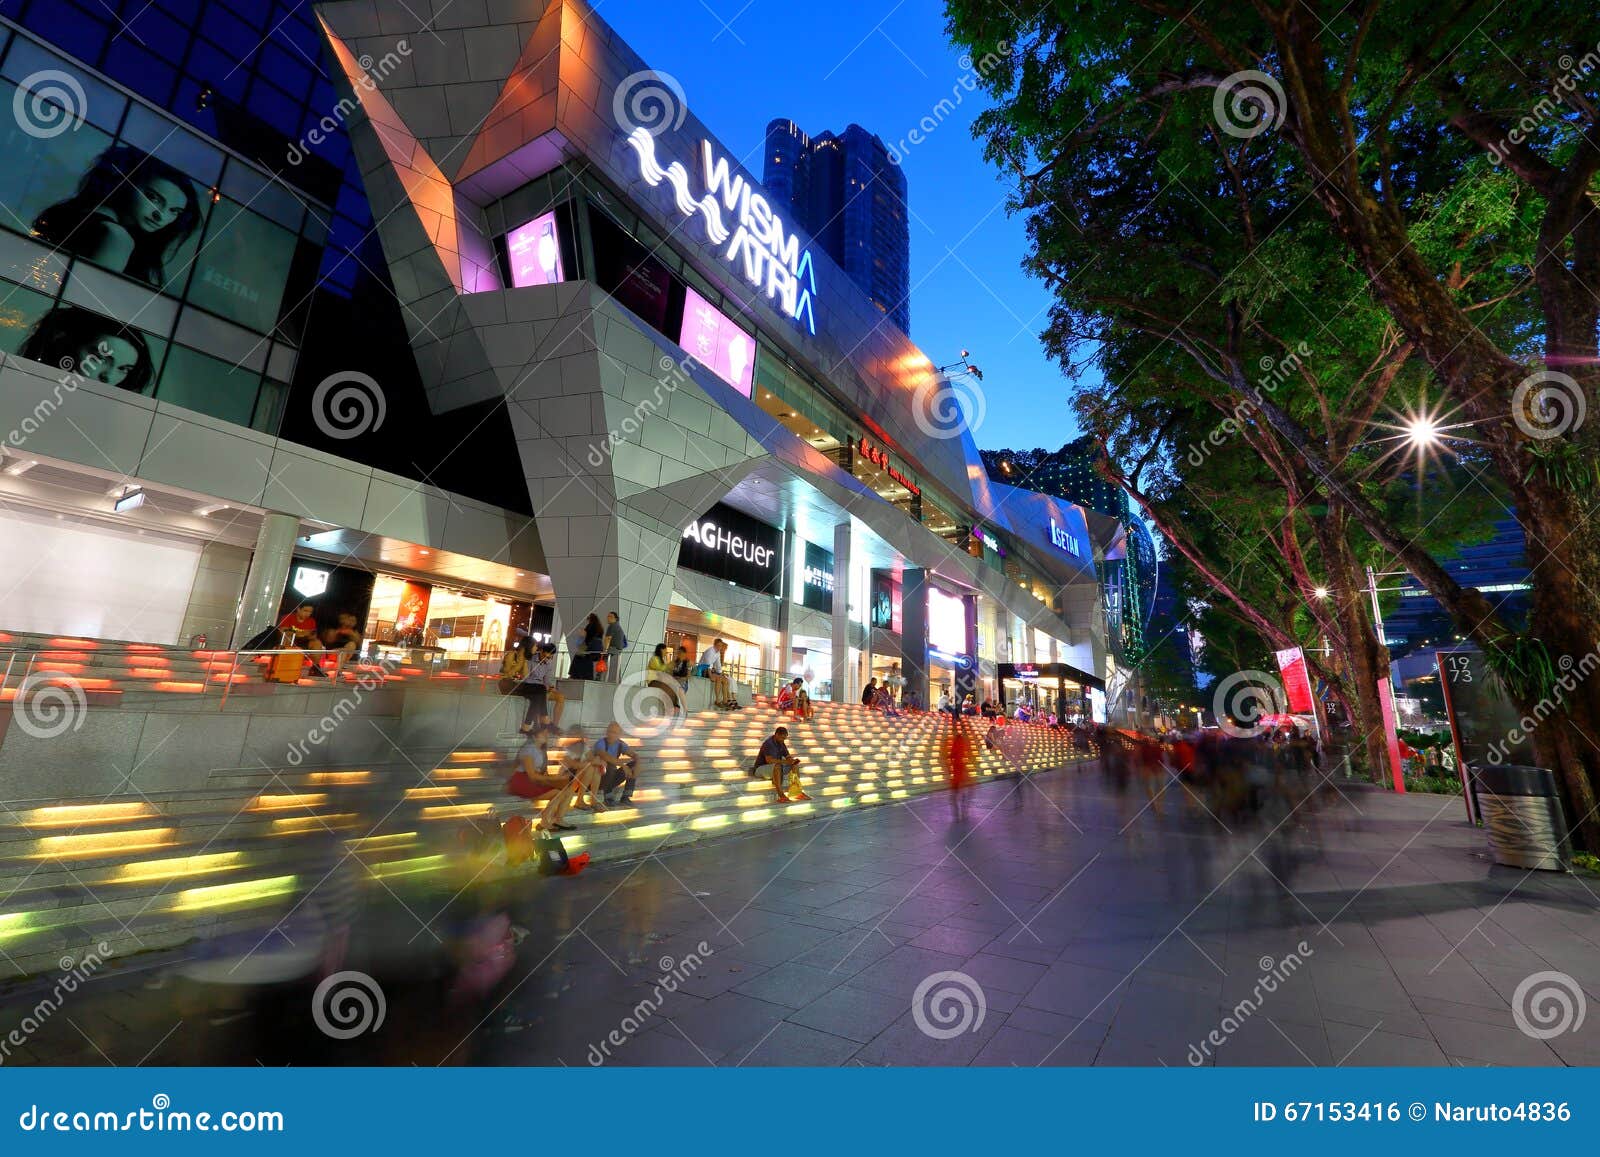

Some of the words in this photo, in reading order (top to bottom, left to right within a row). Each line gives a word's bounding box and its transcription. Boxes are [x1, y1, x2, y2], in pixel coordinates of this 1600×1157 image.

[702, 138, 816, 296] WISMA
[726, 224, 816, 336] ATRIA
[1050, 517, 1080, 558] ISETAN
[1449, 656, 1470, 670] 19
[1450, 669, 1473, 683] 73
